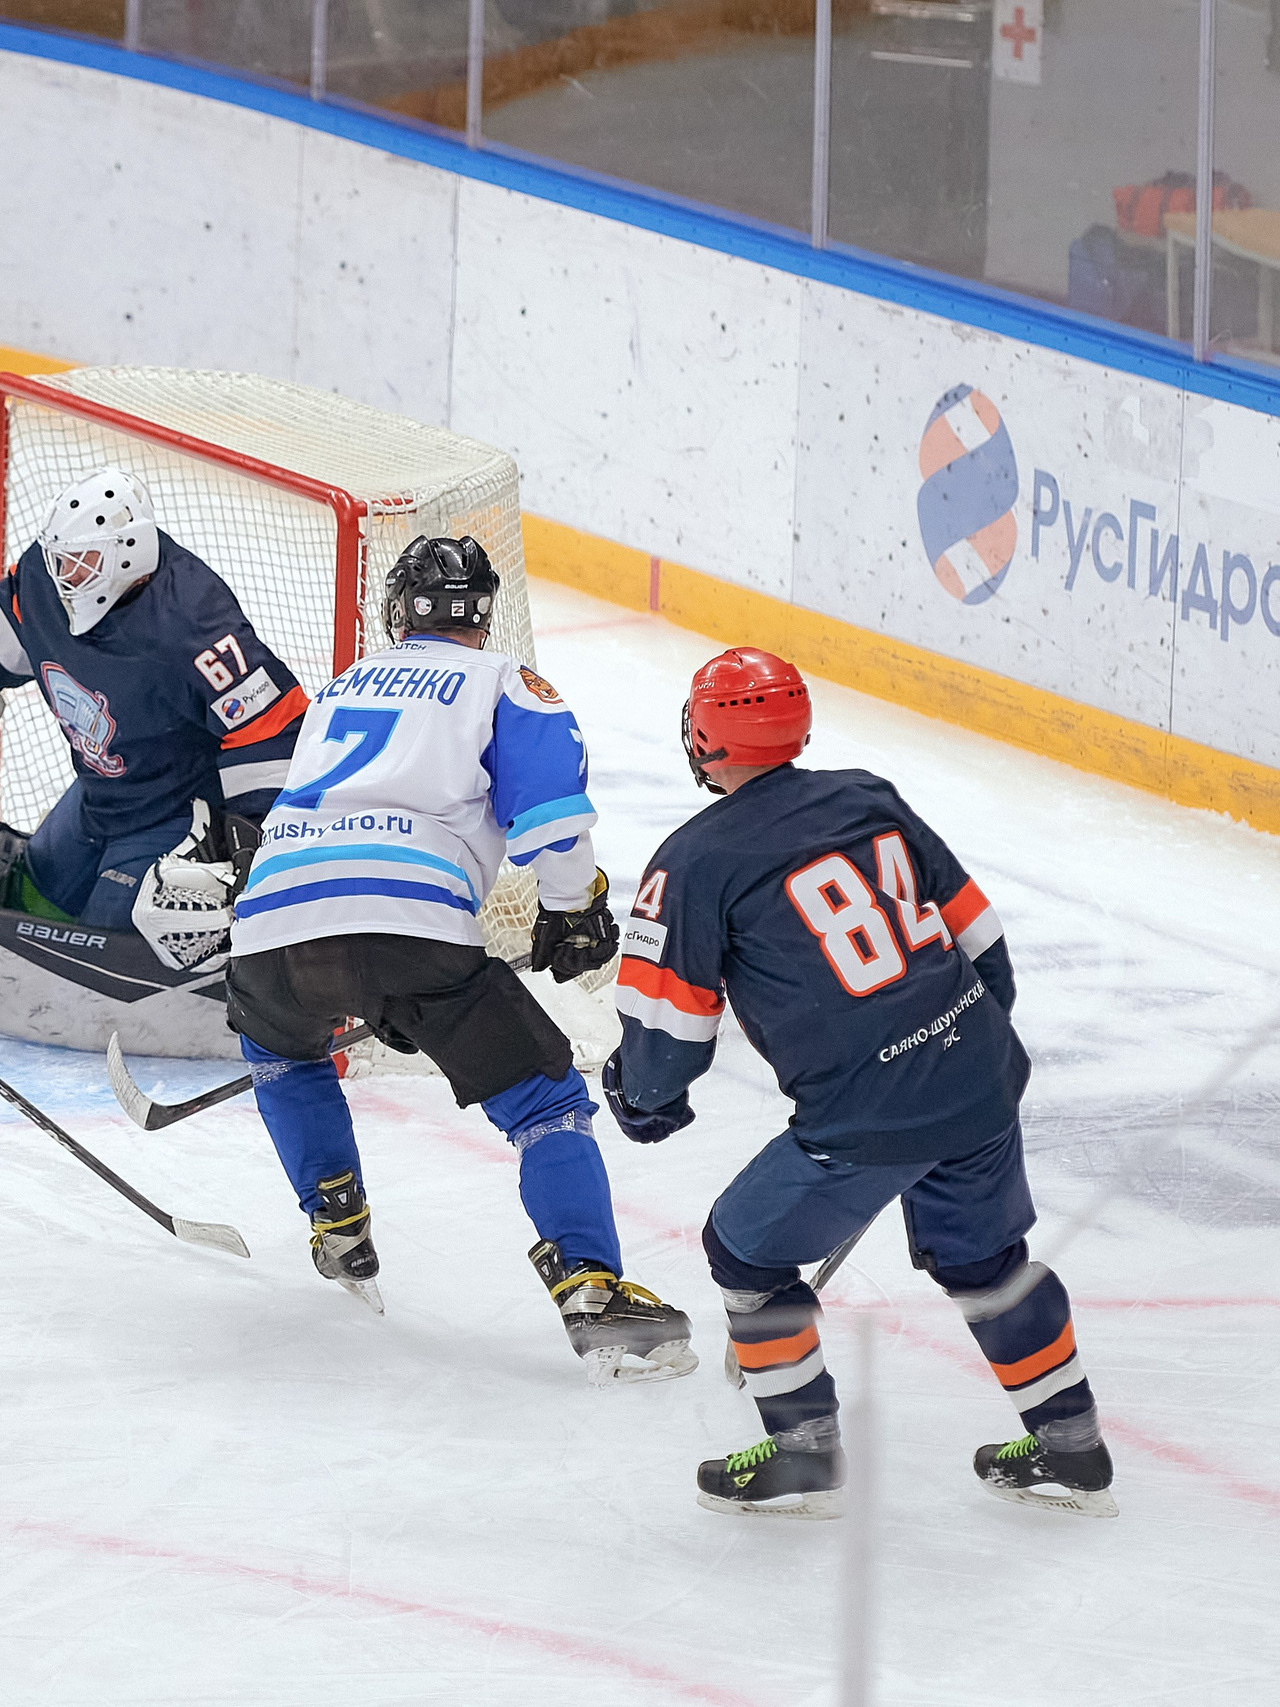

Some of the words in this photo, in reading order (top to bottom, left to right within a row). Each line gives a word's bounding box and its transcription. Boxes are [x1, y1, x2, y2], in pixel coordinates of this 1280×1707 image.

[193, 633, 249, 692] 67
[270, 706, 403, 812] 7
[784, 830, 955, 998] 84
